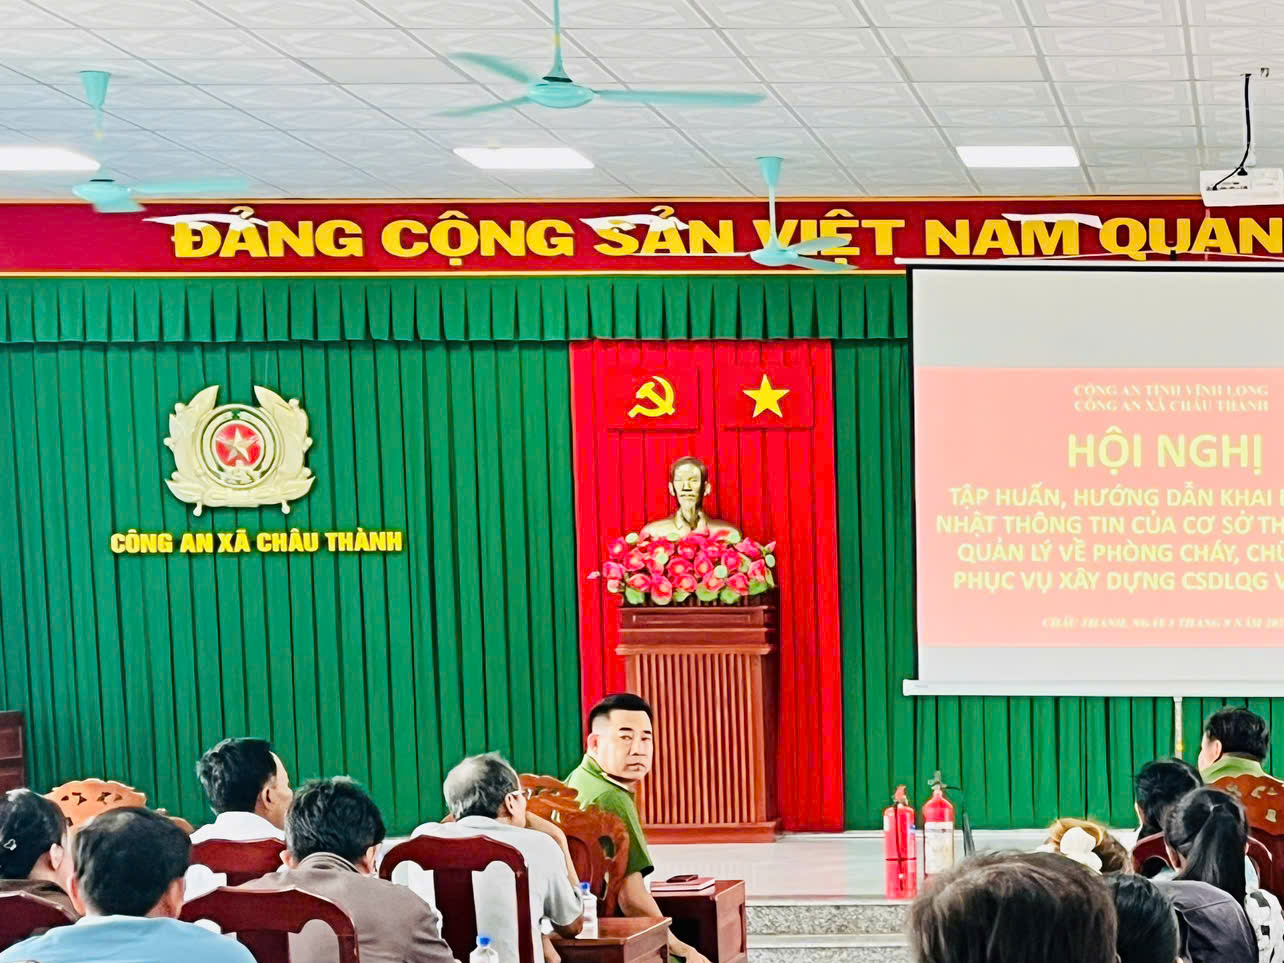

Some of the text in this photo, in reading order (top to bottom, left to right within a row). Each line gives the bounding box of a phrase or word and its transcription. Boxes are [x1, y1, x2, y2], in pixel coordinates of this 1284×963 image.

[171, 205, 362, 258] ĐẢNG
[381, 210, 575, 266] CỘNG
[593, 205, 734, 257] SẢN
[752, 208, 905, 264] VIỆT
[925, 218, 1079, 257] NAM
[1067, 425, 1264, 475] HỘI NGHỊ
[949, 483, 990, 510] TẬP
[996, 481, 1066, 510] HUẤN,
[1074, 483, 1159, 507] HƯỚNG
[1167, 481, 1214, 507] DẪN
[1220, 488, 1273, 507] KHAI
[936, 510, 997, 538] NHẬT
[1002, 511, 1083, 534] THÔNG
[1088, 515, 1125, 534] TIN
[1131, 509, 1177, 535] CỦA
[1182, 514, 1216, 534] CƠ
[1221, 509, 1254, 535] SỞ
[110, 527, 402, 554] CÔNG AN XÃ CHÂU THÀNH
[957, 536, 1024, 563] QUẢN
[1030, 539, 1054, 562] LÝ
[1059, 537, 1087, 562] VỀ
[1093, 539, 1174, 562] PHÒNG
[1179, 539, 1240, 565] CHÁY,
[953, 571, 1016, 595] PHỤC
[1020, 571, 1053, 594] VỤ
[1059, 566, 1101, 590] XÂY
[1106, 571, 1176, 595] DỰNG
[1181, 571, 1269, 592] CSDLQG
